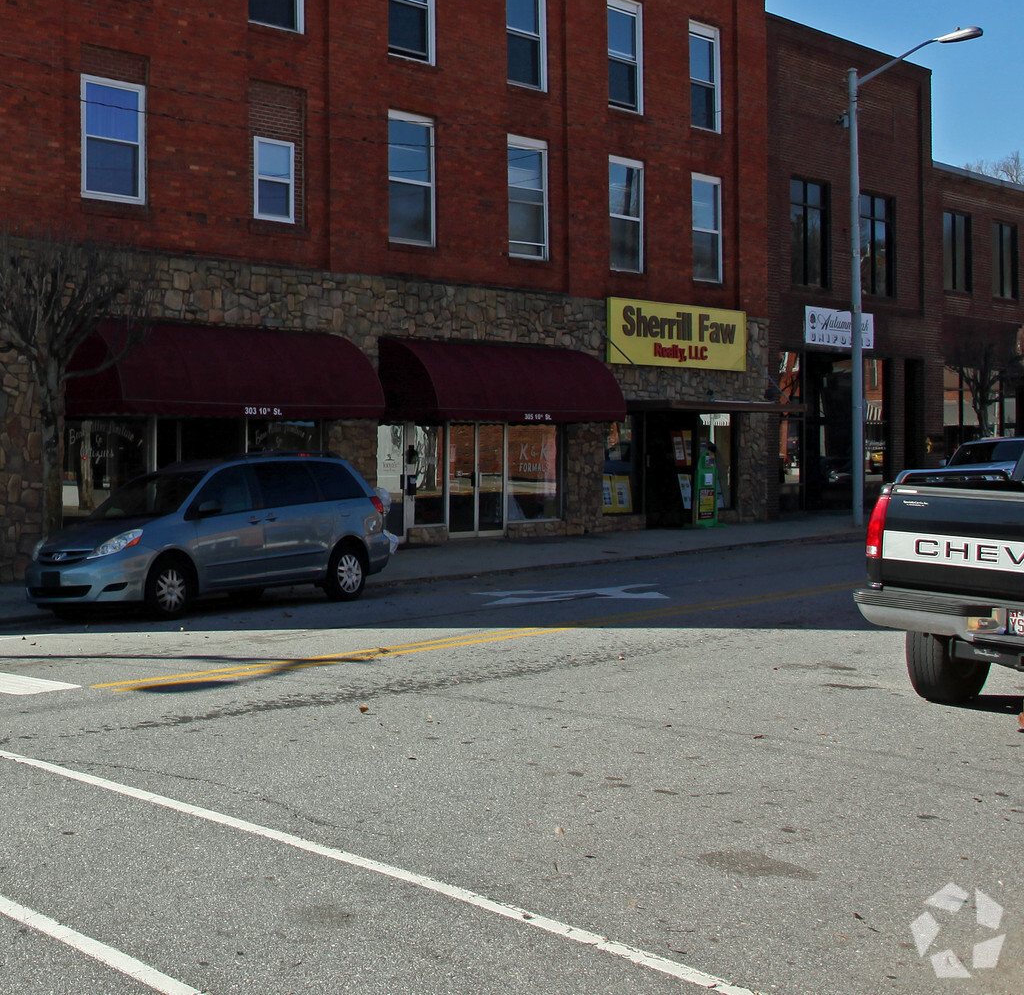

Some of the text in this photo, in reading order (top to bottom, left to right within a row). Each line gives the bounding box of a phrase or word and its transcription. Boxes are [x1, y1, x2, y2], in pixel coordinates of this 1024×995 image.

[622, 305, 736, 344] Sherrill Faw
[653, 342, 708, 362] Realty, LLC
[244, 406, 257, 415] 303
[273, 407, 283, 416] St.
[519, 442, 528, 461] K
[540, 442, 549, 461] K
[519, 462, 550, 473] FORMALS
[915, 538, 1024, 565] CHEV
